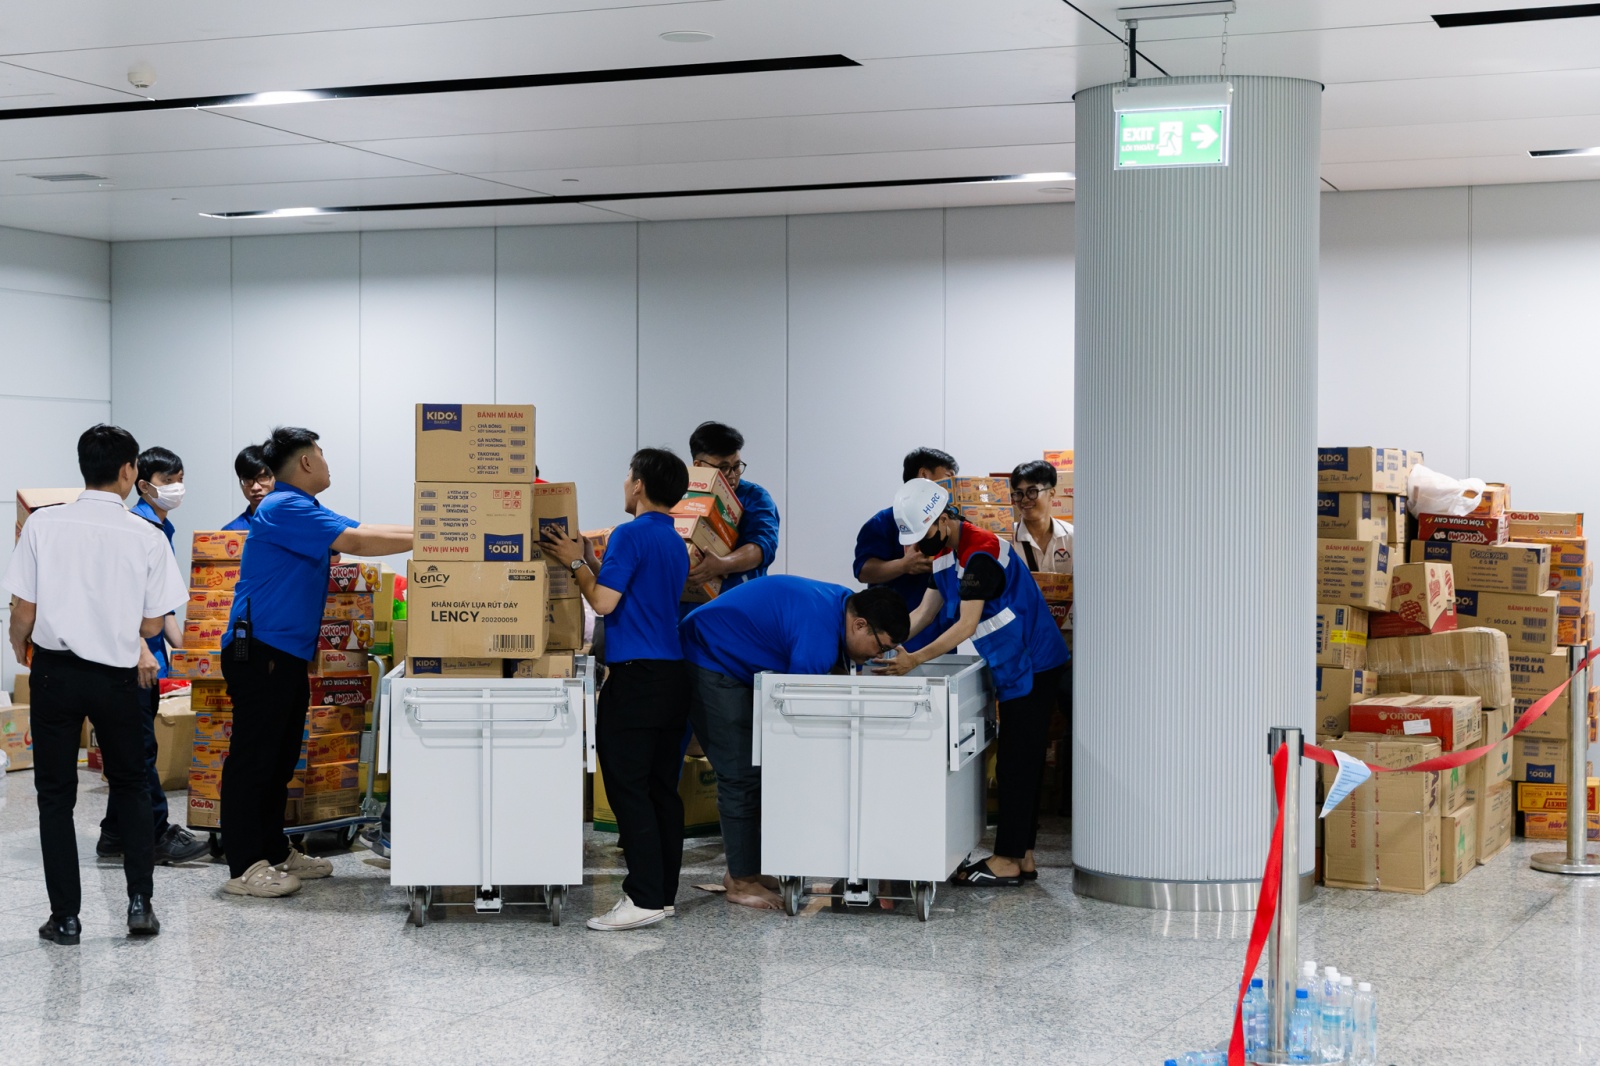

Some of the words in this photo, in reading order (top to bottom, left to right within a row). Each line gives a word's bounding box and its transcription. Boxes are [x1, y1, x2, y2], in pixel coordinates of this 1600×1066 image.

[1122, 127, 1154, 142] EXIT
[922, 492, 940, 514] HURC
[1448, 531, 1485, 543] KOKOMI
[339, 578, 348, 587] 90
[1456, 597, 1473, 606] DO's
[432, 611, 479, 622] LENCY
[331, 637, 340, 645] 90
